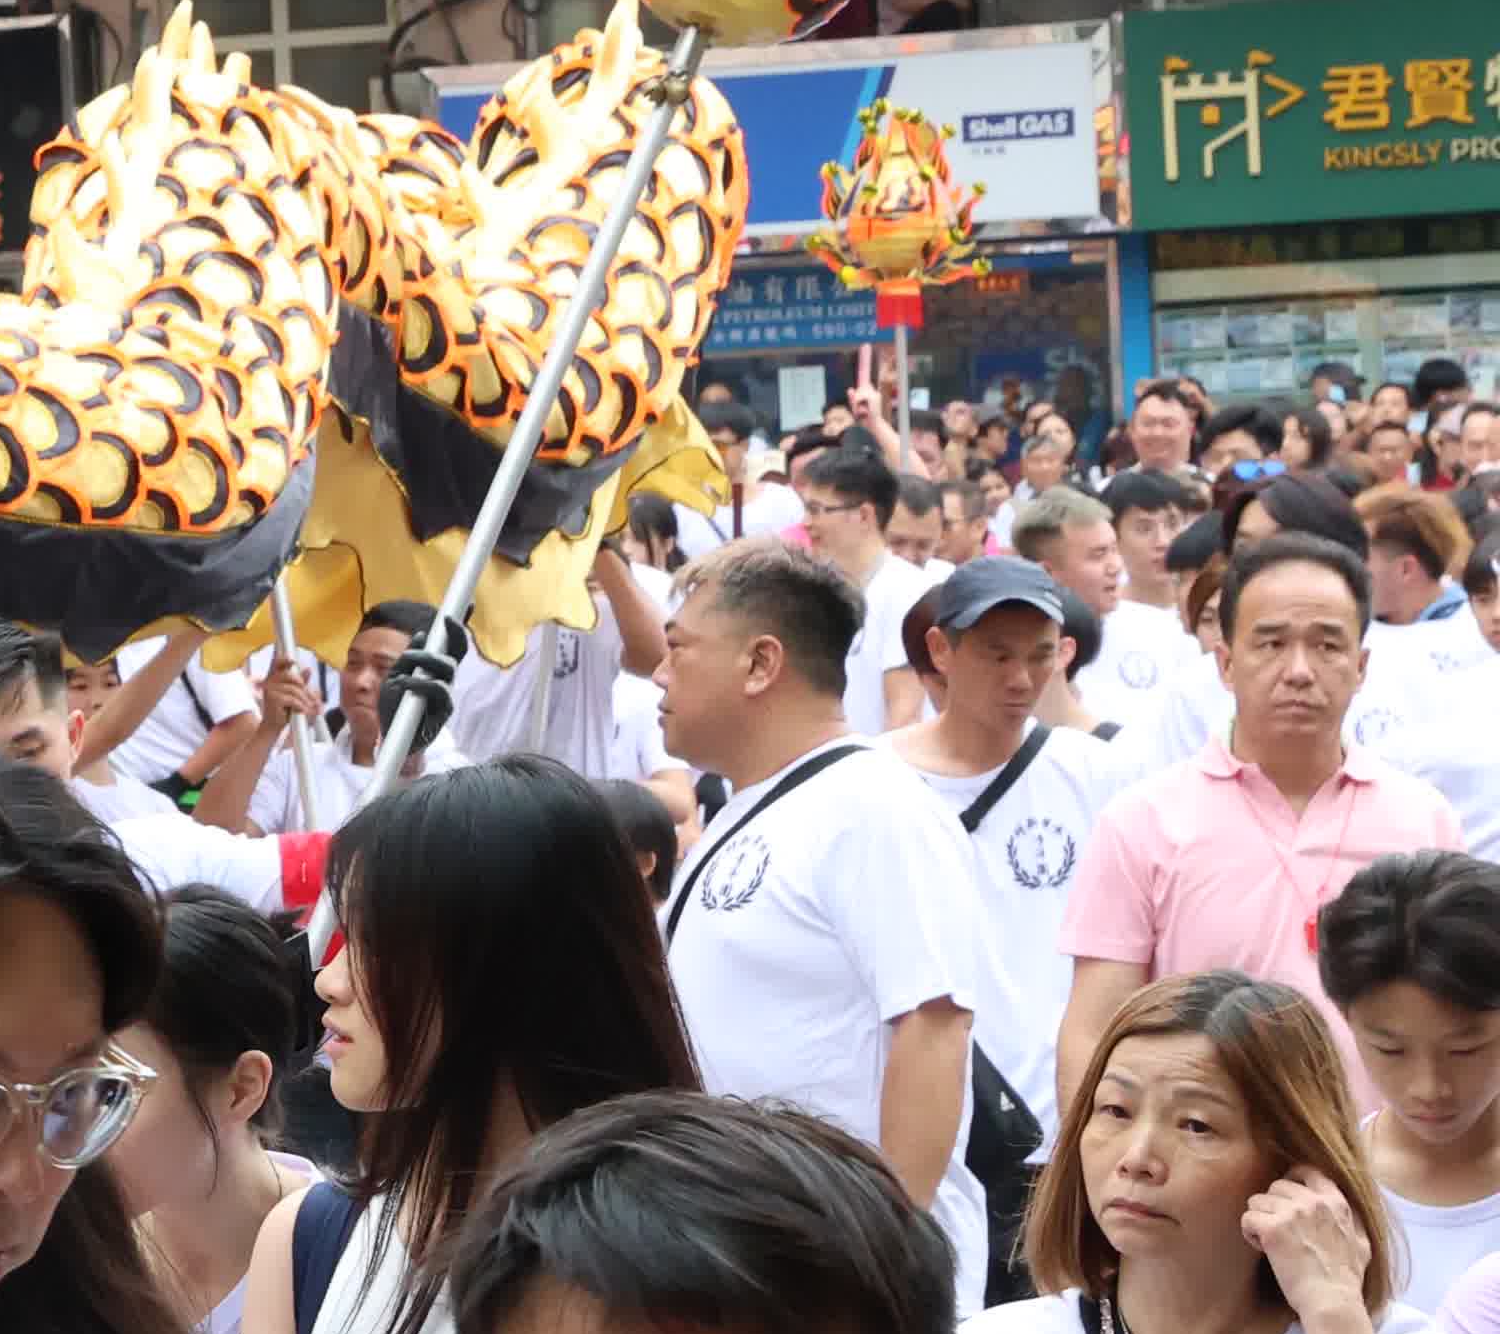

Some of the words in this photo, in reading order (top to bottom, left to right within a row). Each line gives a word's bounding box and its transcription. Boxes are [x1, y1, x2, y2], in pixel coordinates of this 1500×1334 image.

[969, 116, 1017, 140] Shell
[1019, 111, 1069, 136] GAS
[1323, 140, 1442, 170] KINGSLY
